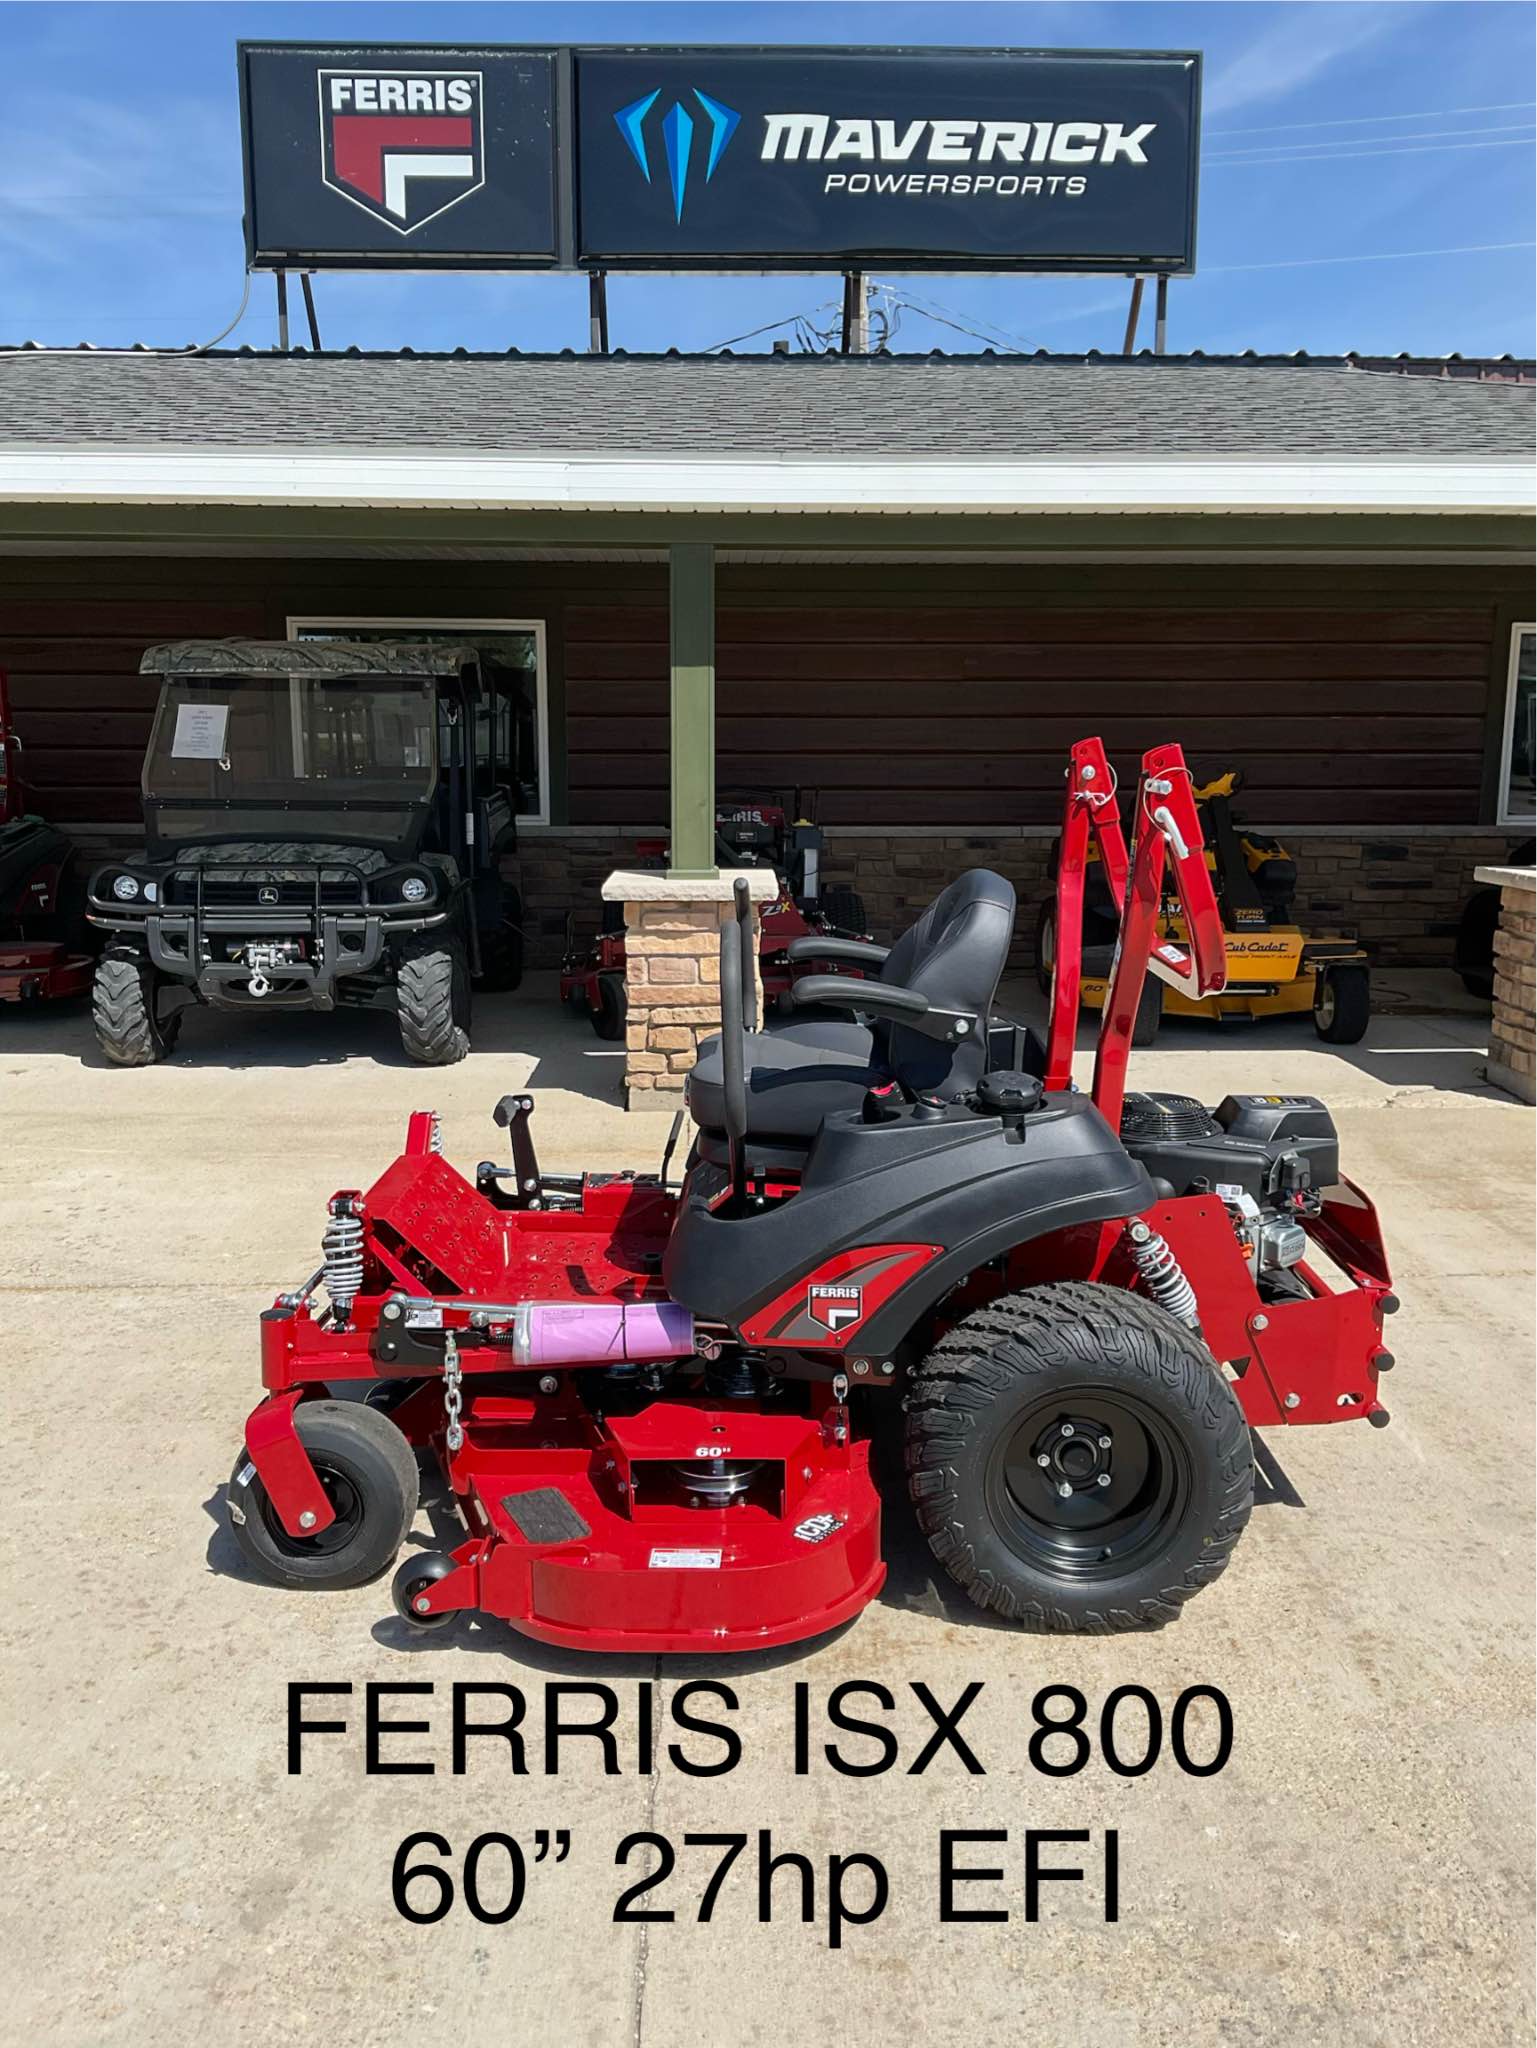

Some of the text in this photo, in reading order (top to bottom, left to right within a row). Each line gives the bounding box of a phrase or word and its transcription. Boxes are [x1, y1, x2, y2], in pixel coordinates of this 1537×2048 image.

[330, 78, 473, 112] FERRIS
[760, 112, 1158, 164] MAVERICK
[824, 173, 1088, 196] POWERSPORTS
[1247, 942, 1289, 952] Cadet
[811, 1287, 859, 1298] FERRIS
